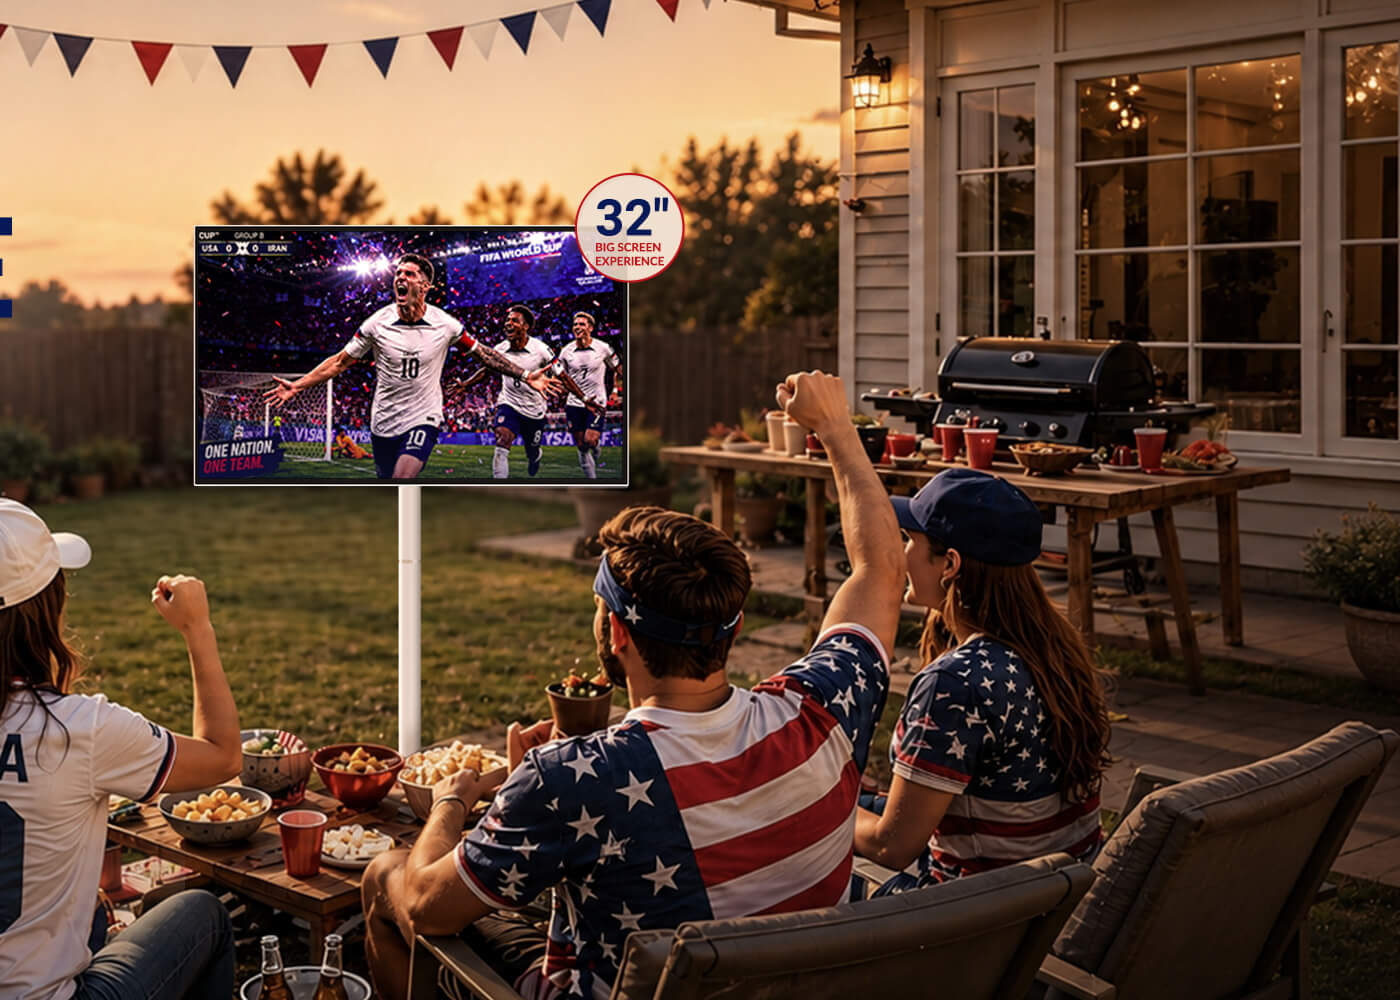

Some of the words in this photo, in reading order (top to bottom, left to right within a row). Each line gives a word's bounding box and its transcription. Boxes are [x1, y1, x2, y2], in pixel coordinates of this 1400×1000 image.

[201, 244, 218, 252] USA
[267, 244, 288, 252] IRAN
[401, 357, 420, 379] 10
[295, 427, 325, 442] VISA
[406, 430, 426, 447] 10
[205, 444, 229, 459] ONE
[230, 440, 275, 456] NATION.
[204, 459, 228, 474] ONE
